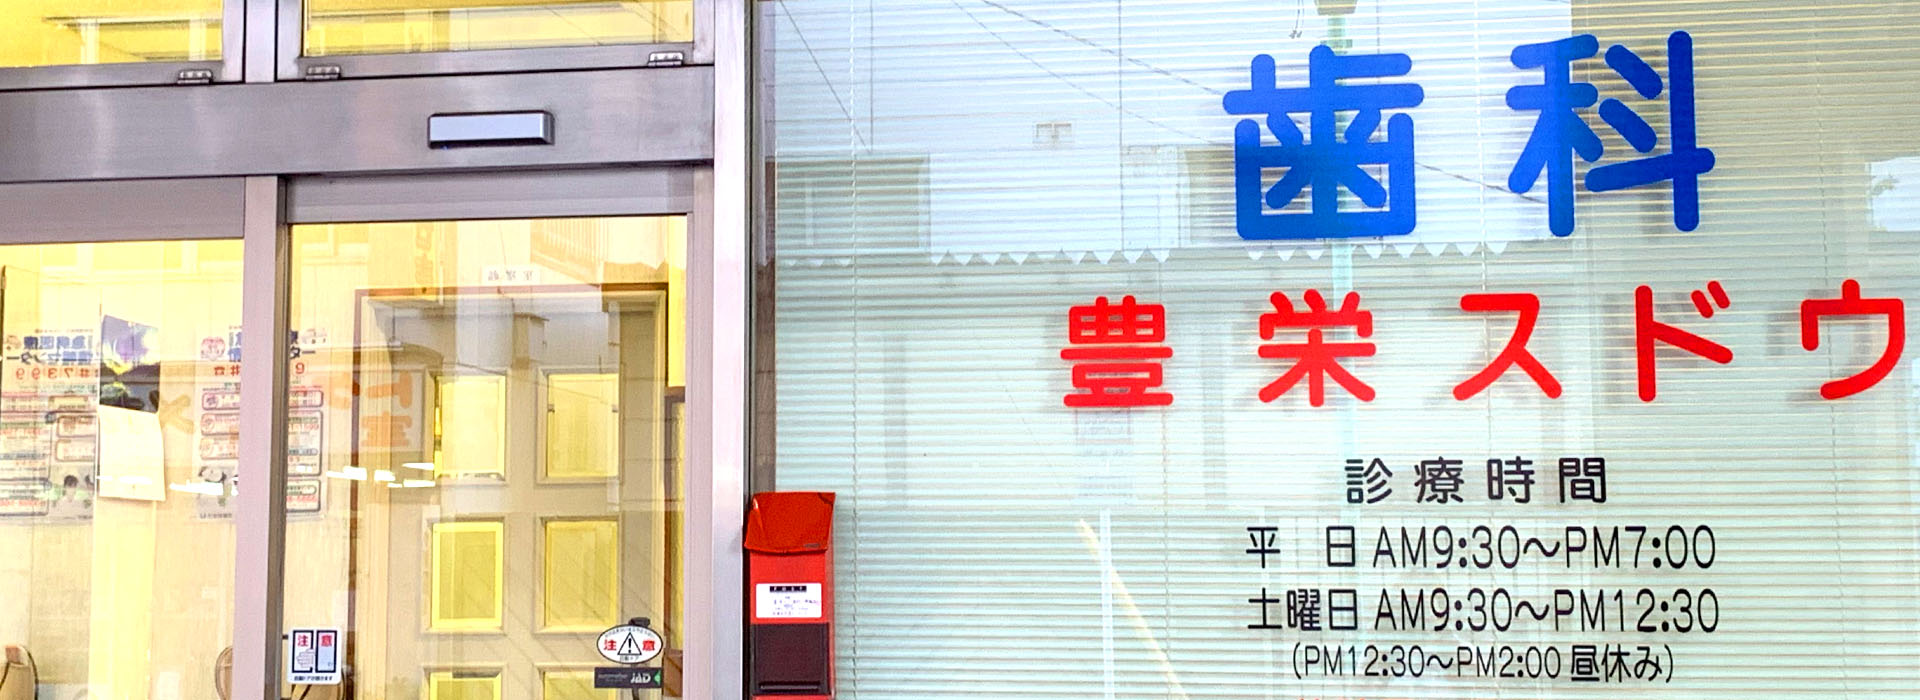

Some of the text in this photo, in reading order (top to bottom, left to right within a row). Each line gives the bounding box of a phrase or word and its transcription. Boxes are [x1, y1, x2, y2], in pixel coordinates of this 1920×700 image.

[1223, 31, 1715, 240] 歯科
[1060, 279, 1905, 408] 豊栄スドウ
[1344, 456, 1607, 504] 診療時間
[1247, 587, 1358, 631] 土曜日
